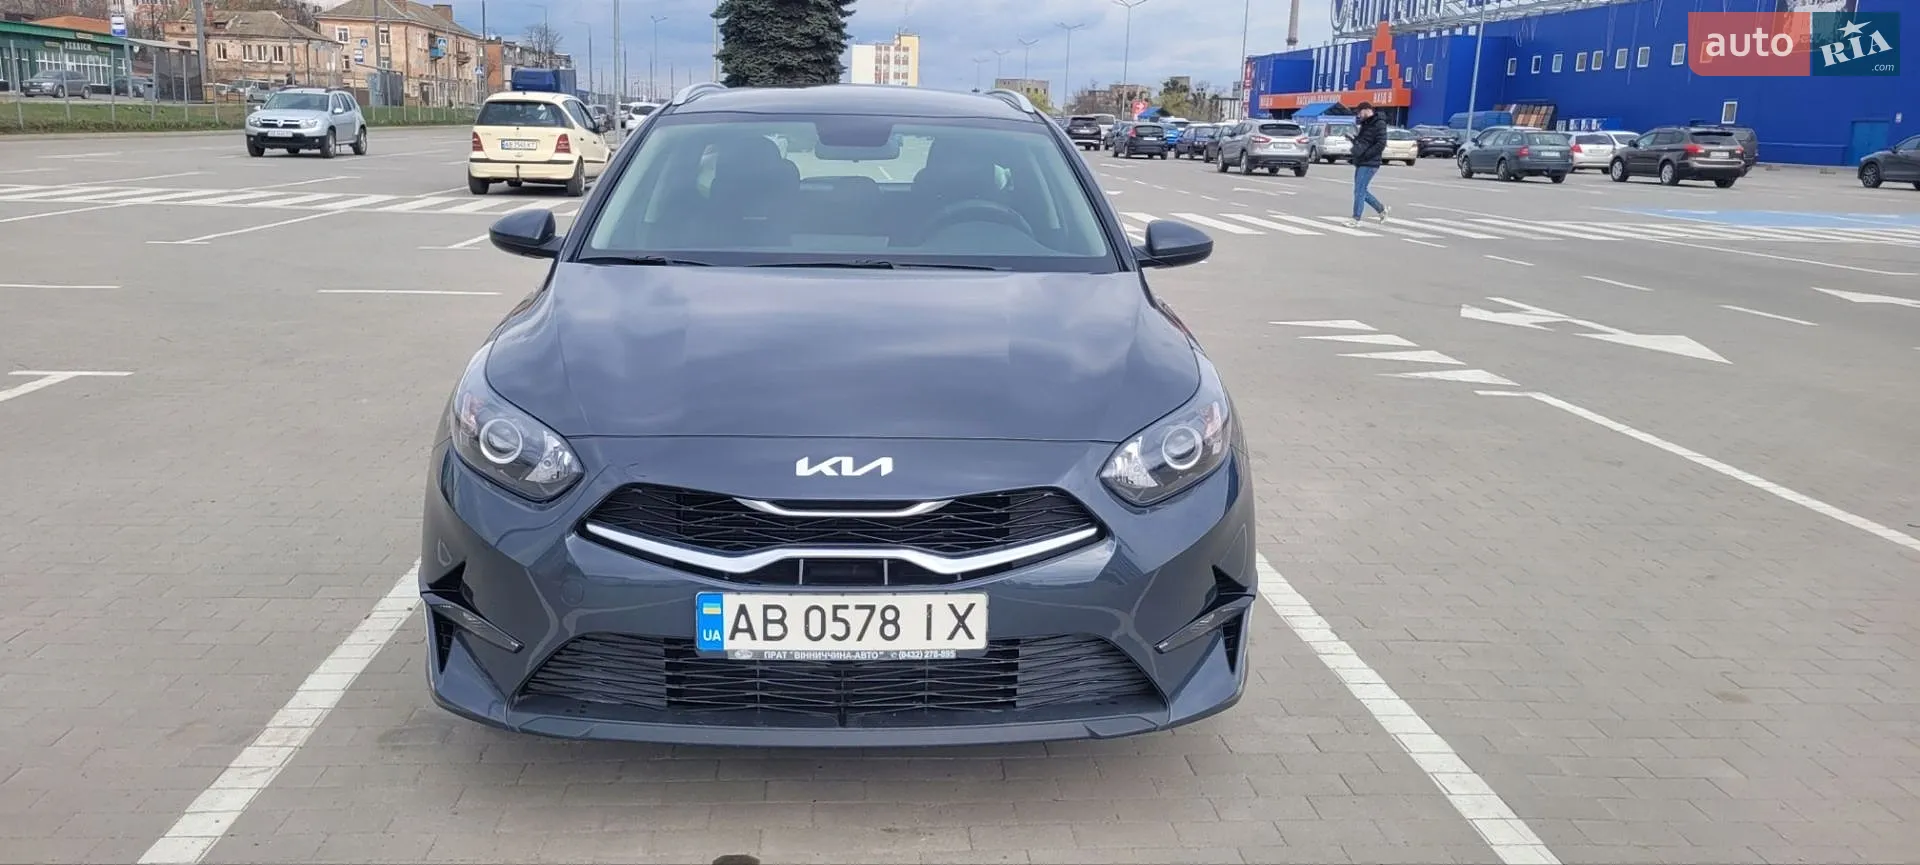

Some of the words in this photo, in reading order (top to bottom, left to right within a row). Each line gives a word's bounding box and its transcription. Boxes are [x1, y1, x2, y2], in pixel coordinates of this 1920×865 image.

[729, 604, 788, 641] AB
[804, 604, 901, 641] 0578
[703, 630, 721, 641] UA
[764, 651, 787, 659] ПРАТ
